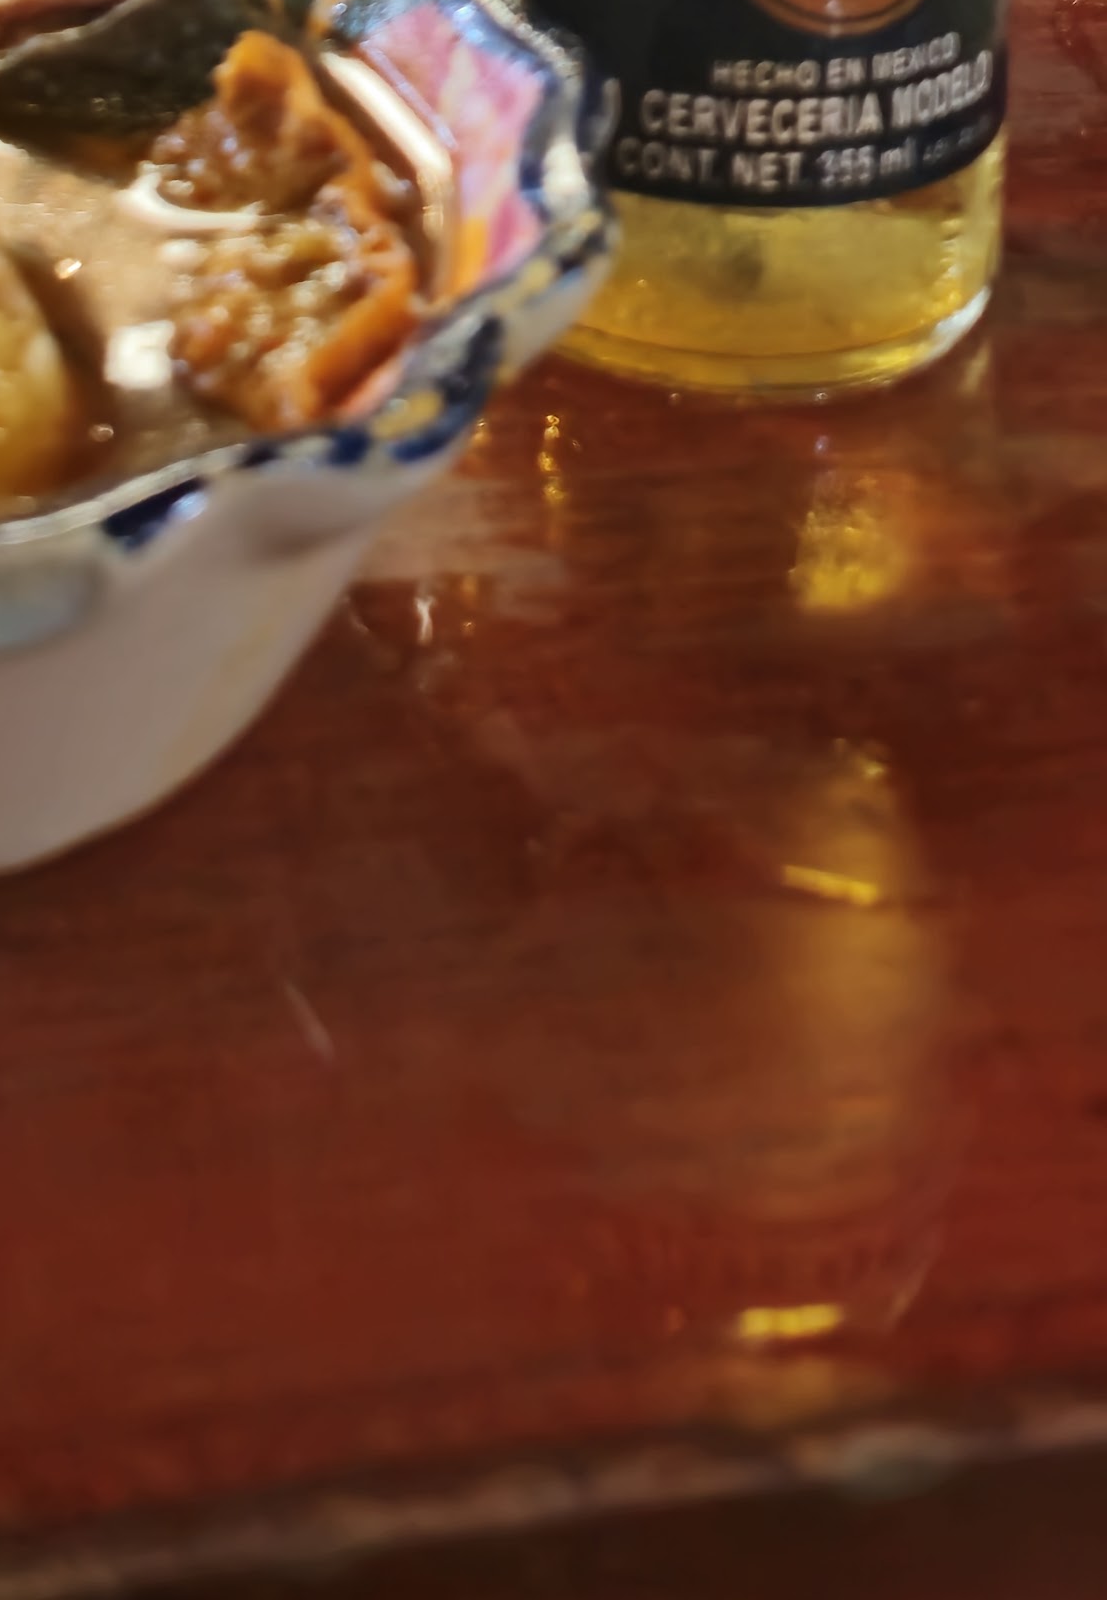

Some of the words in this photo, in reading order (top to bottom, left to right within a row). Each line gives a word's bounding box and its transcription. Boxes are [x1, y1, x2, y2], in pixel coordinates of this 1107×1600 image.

[640, 88, 884, 146] CERVECERIA
[891, 48, 993, 130] MODELO
[711, 58, 821, 91] HECHO
[825, 56, 867, 88] EN
[815, 143, 877, 188] 355
[879, 136, 918, 175] ml
